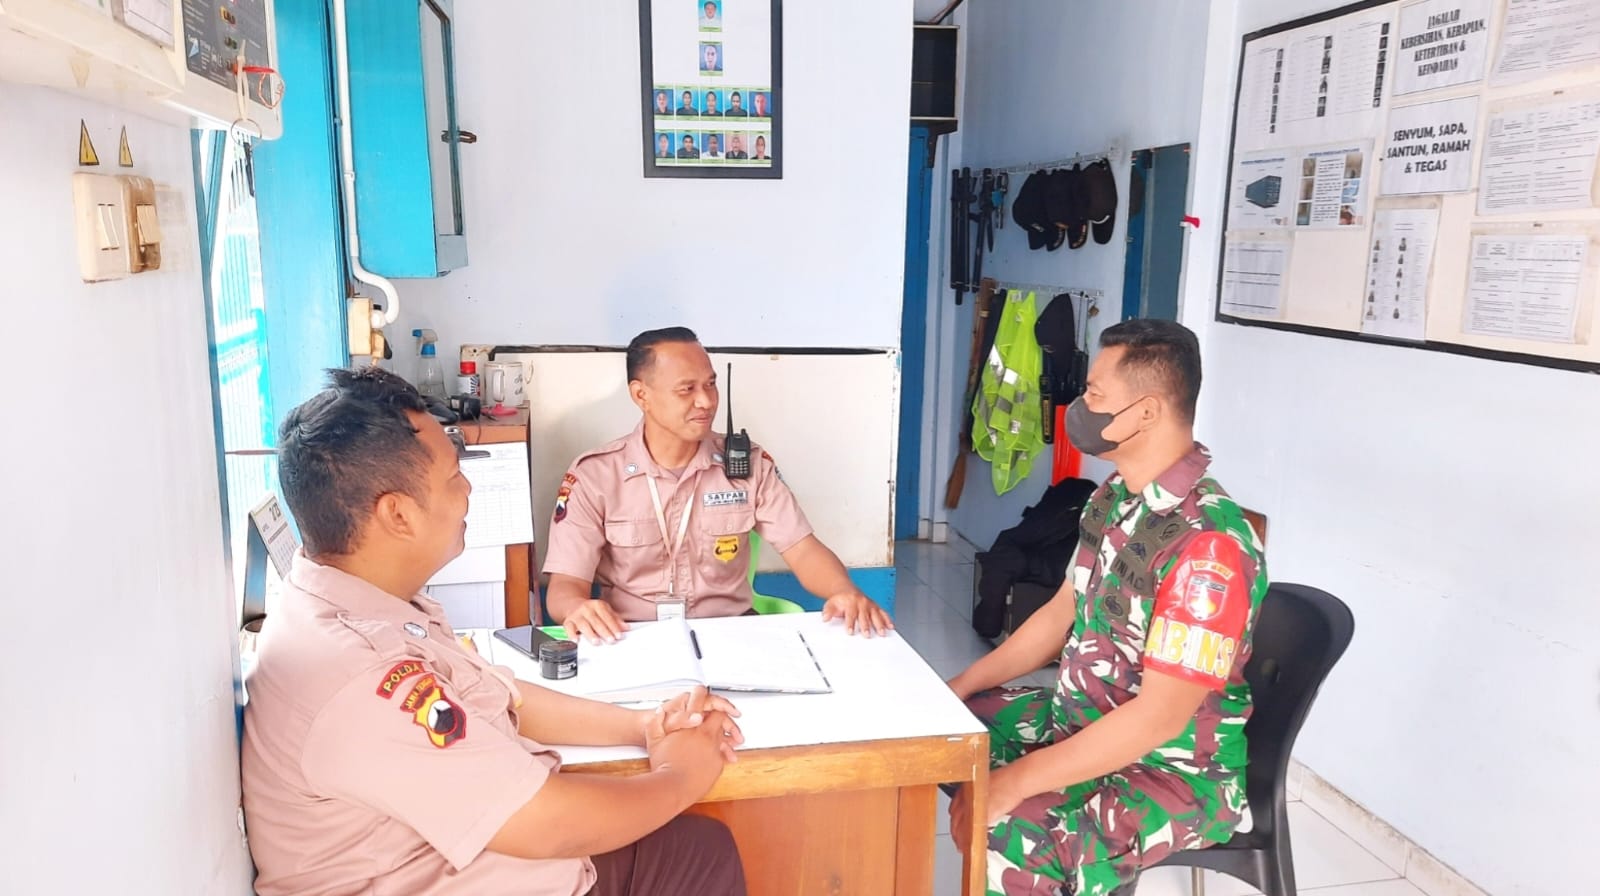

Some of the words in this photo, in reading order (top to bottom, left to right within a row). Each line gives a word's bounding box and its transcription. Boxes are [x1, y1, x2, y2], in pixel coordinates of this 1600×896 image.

[1459, 39, 1466, 51] &
[1393, 126, 1436, 141] SENYUM,
[1439, 122, 1468, 136] SAPA,
[1387, 144, 1429, 158] SANTUN,
[1431, 139, 1471, 154] RAMAH
[1404, 162, 1412, 173] &
[1415, 159, 1447, 173] TEGAS
[707, 492, 744, 500] SATPAM
[382, 663, 420, 693] POLDA
